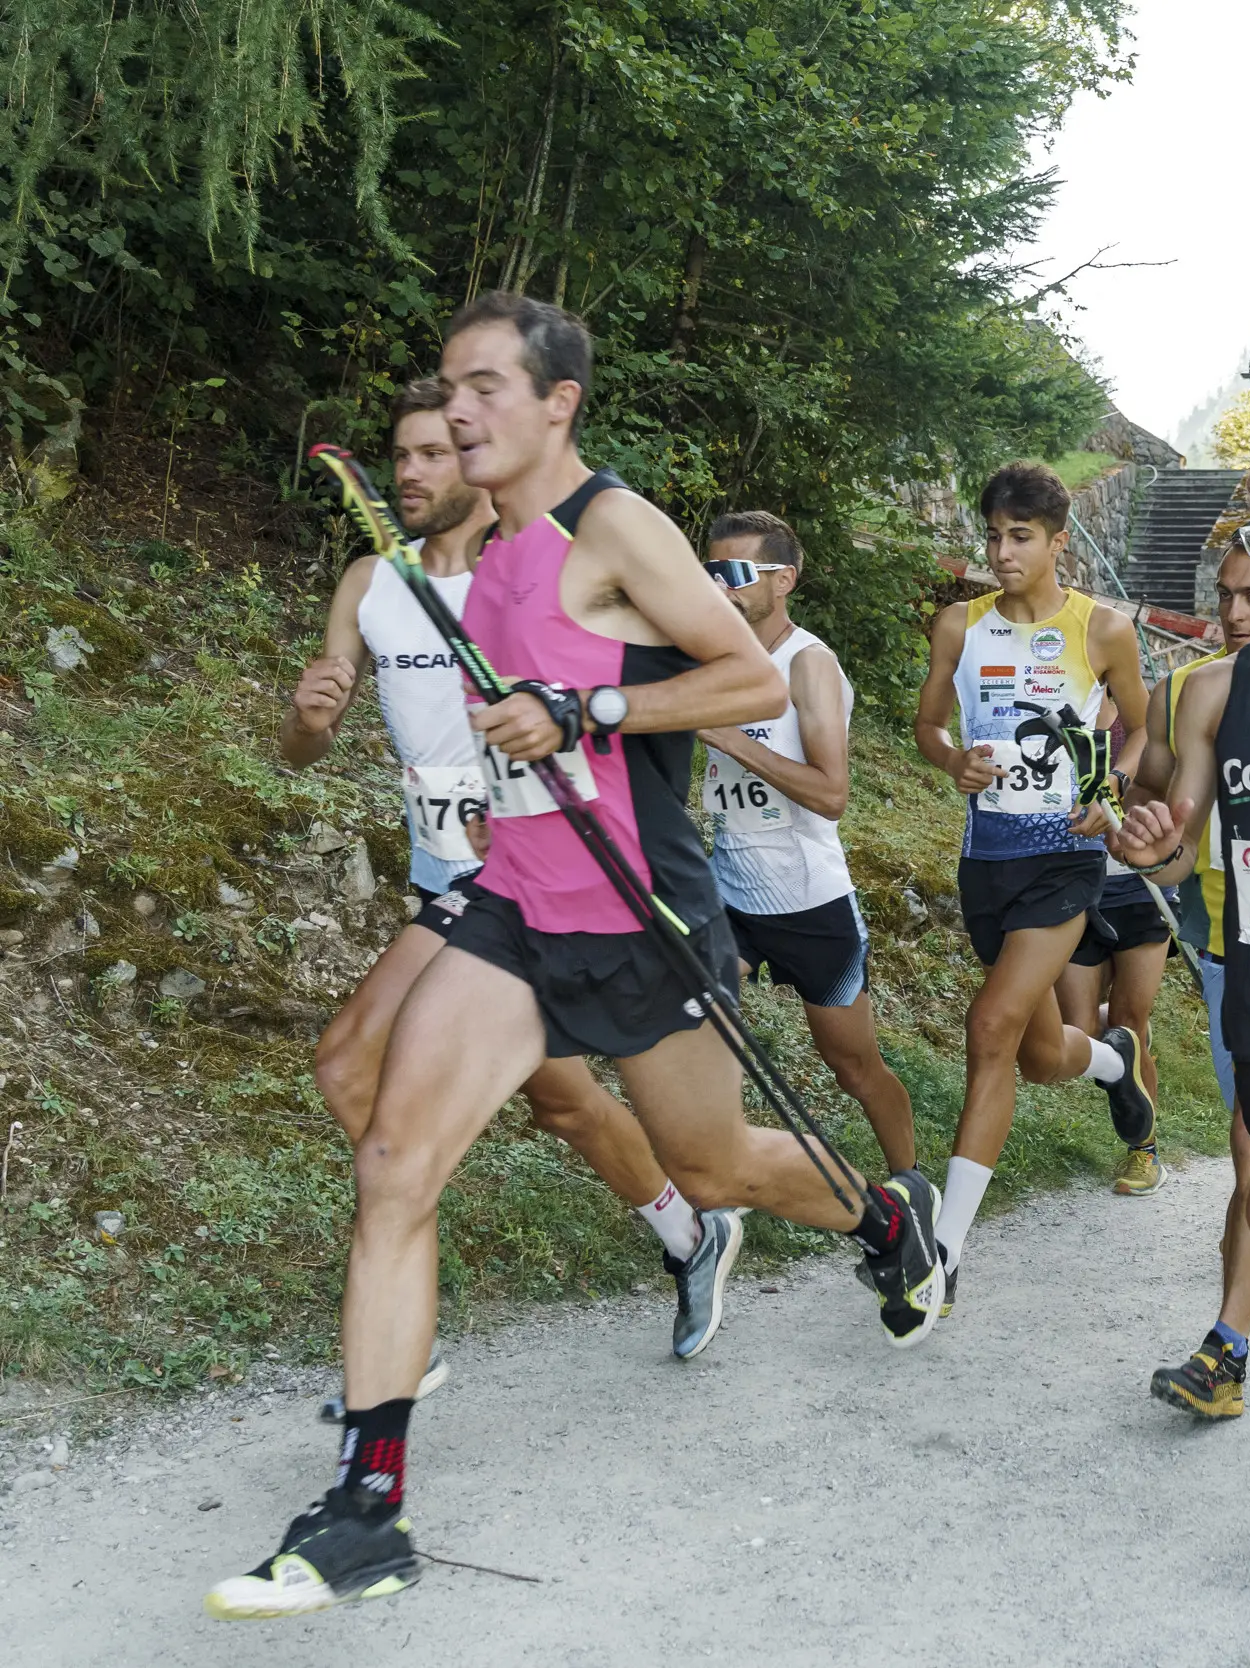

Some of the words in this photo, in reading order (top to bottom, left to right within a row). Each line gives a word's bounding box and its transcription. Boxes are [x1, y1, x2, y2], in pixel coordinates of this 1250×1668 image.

[992, 706, 1021, 717] AVIS
[485, 745, 526, 780] 12
[994, 764, 1053, 791] 139
[714, 781, 768, 810] 116
